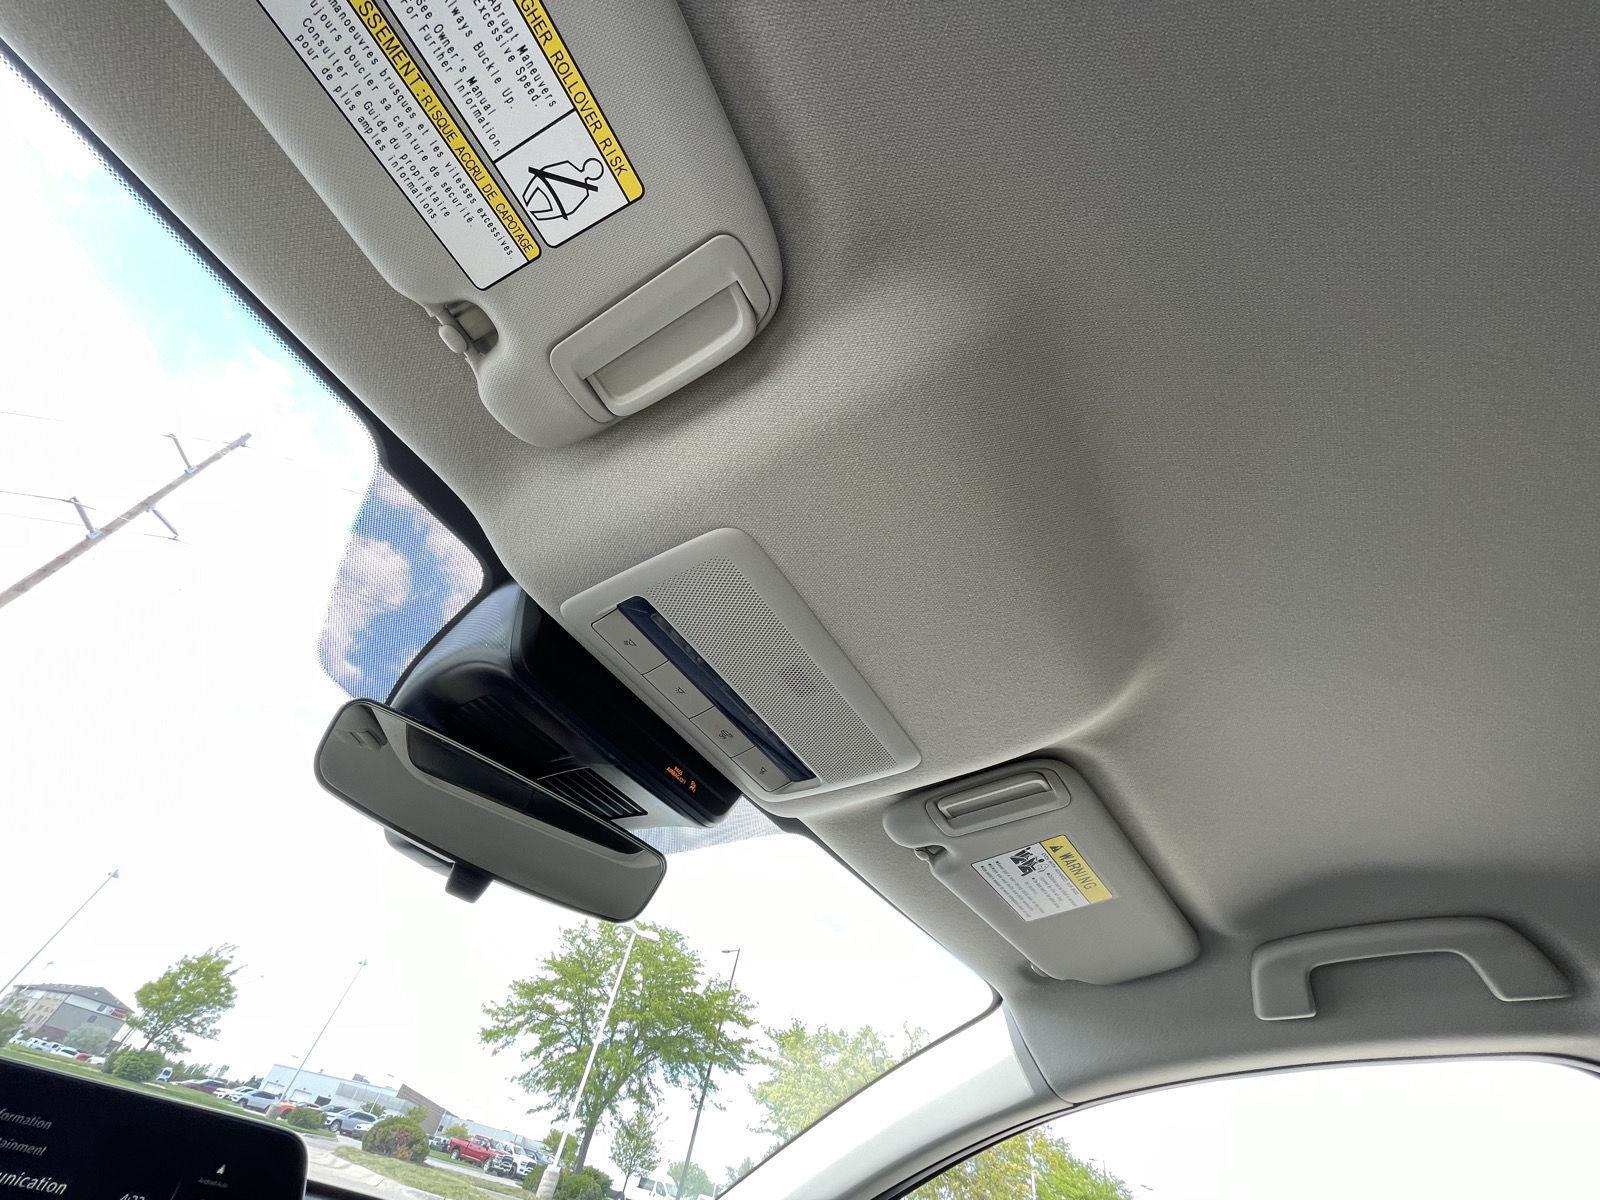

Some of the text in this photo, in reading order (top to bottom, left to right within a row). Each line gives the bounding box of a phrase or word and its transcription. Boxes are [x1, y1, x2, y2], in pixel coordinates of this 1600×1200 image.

[295, 34, 319, 61] pour
[321, 67, 333, 81] de
[335, 86, 356, 111] plus
[357, 116, 386, 152] amples
[344, 46, 379, 92] boucler
[380, 98, 392, 111] sa
[393, 116, 429, 162] ceinture
[429, 165, 440, 178] de
[419, 24, 453, 73] Further
[454, 79, 500, 152] Information.
[433, 24, 467, 73] Owner's
[466, 76, 496, 116] Manual
[445, 0, 514, 110] lways Buckle Up.
[488, 0, 556, 107] Abrupt Maneuvers
[515, 67, 540, 107] Speed.
[521, 0, 628, 176] GHER ROLLOVER RISK
[302, 18, 450, 218] Consulter le Guide du propriétaire
[379, 68, 417, 119] brusques
[418, 123, 430, 136] et
[431, 139, 443, 158] les
[445, 162, 477, 205] vitesses
[477, 207, 513, 260] excessives.
[421, 95, 457, 144] RISQUE
[456, 146, 485, 182] ACCRU
[482, 183, 498, 201] DE
[495, 203, 533, 254] CAPOTAGE
[1059, 852, 1097, 891] WARNING
